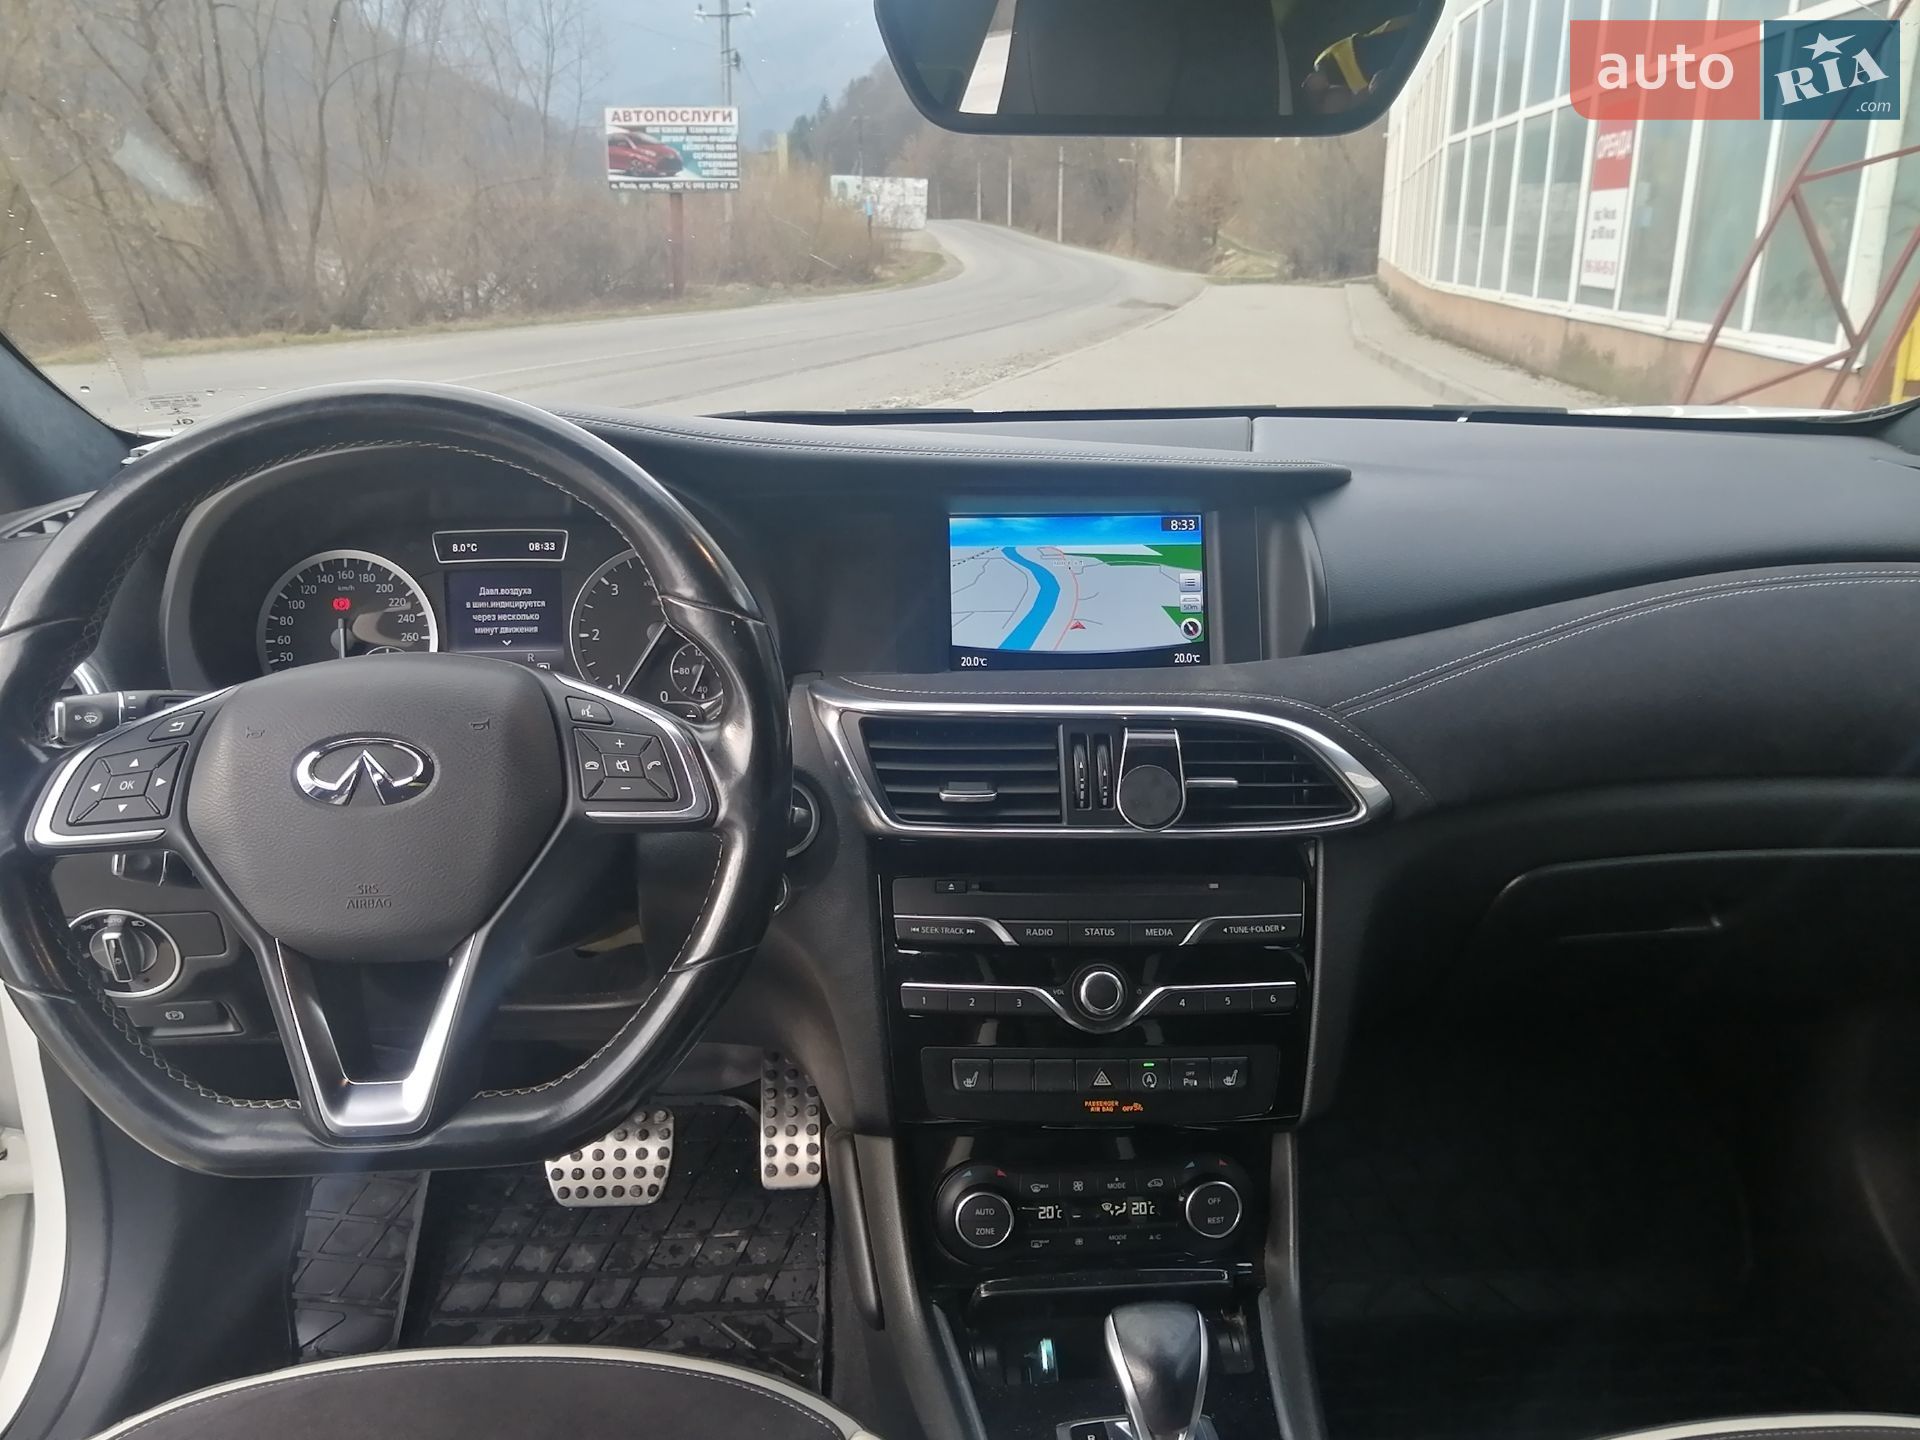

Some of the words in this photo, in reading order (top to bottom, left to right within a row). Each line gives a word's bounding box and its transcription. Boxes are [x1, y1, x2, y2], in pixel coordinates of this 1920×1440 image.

[611, 110, 733, 122] АВТОПОСЛУГИ
[1171, 520, 1195, 530] 8:33
[452, 543, 478, 552] 8.0°C
[528, 542, 555, 551] 08:33
[317, 574, 334, 584] 140
[337, 570, 354, 580] 160
[359, 573, 376, 583] 180
[300, 585, 317, 594] 120
[376, 584, 394, 593] 200
[479, 587, 532, 596] Давл.воздуха
[611, 584, 619, 595] 3
[288, 600, 305, 610] 100
[389, 597, 406, 607] 220
[1183, 603, 1198, 611] 50m
[280, 616, 294, 626] 80
[398, 614, 415, 623] 240
[472, 614, 496, 622] через
[497, 612, 540, 621] несколько
[475, 627, 499, 635] минут
[499, 625, 538, 634] движения
[401, 632, 419, 642] 260
[592, 629, 600, 641] 2
[277, 635, 291, 645] 60
[280, 652, 294, 662] 50
[527, 653, 535, 662] R
[616, 674, 621, 686] 1
[660, 690, 668, 702] 0
[119, 780, 135, 791] OK
[357, 884, 379, 895] SRS
[346, 897, 392, 909] AIRBAG
[1026, 928, 1054, 936] RADIO
[1084, 928, 1115, 936] STATUS
[1145, 928, 1173, 936] MEDIA
[922, 996, 926, 1005] 1
[969, 998, 975, 1007] 2
[1016, 998, 1022, 1007] 3
[1179, 998, 1186, 1007] 4
[1225, 997, 1231, 1005] 5
[1270, 994, 1276, 1003] 6
[1107, 1182, 1126, 1190] MODE
[1207, 1197, 1221, 1205] OFF
[975, 1208, 995, 1216] AUTO
[1207, 1216, 1224, 1224] REST
[975, 1228, 995, 1236] ZONE
